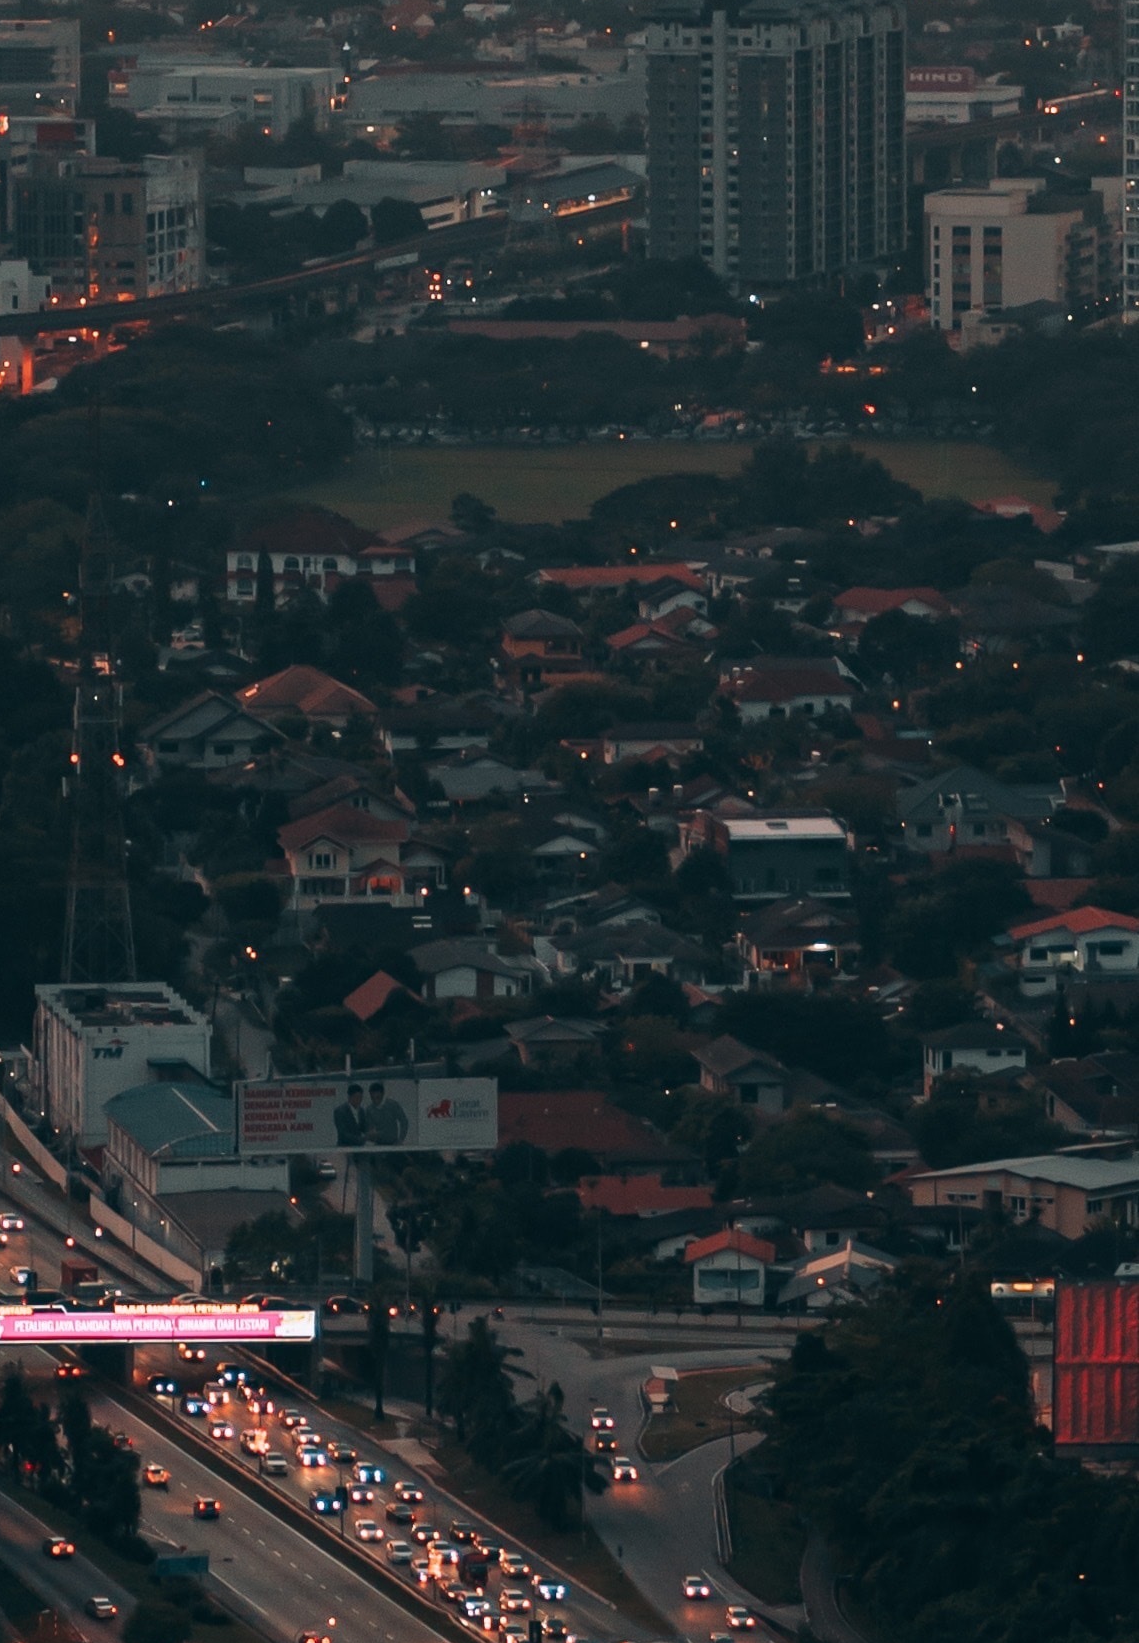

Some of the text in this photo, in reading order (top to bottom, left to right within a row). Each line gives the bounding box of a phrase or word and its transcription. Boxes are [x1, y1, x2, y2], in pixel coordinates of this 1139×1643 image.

[910, 73, 962, 82] HINO
[92, 1047, 124, 1059] TM
[14, 1319, 54, 1333] PETALING
[54, 1319, 75, 1332] JAYA
[75, 1319, 110, 1332] BANDAR
[111, 1319, 133, 1332] RAYA
[178, 1319, 216, 1331] DINAMIK
[217, 1319, 235, 1331] DAN
[236, 1319, 269, 1331] LESTARI
